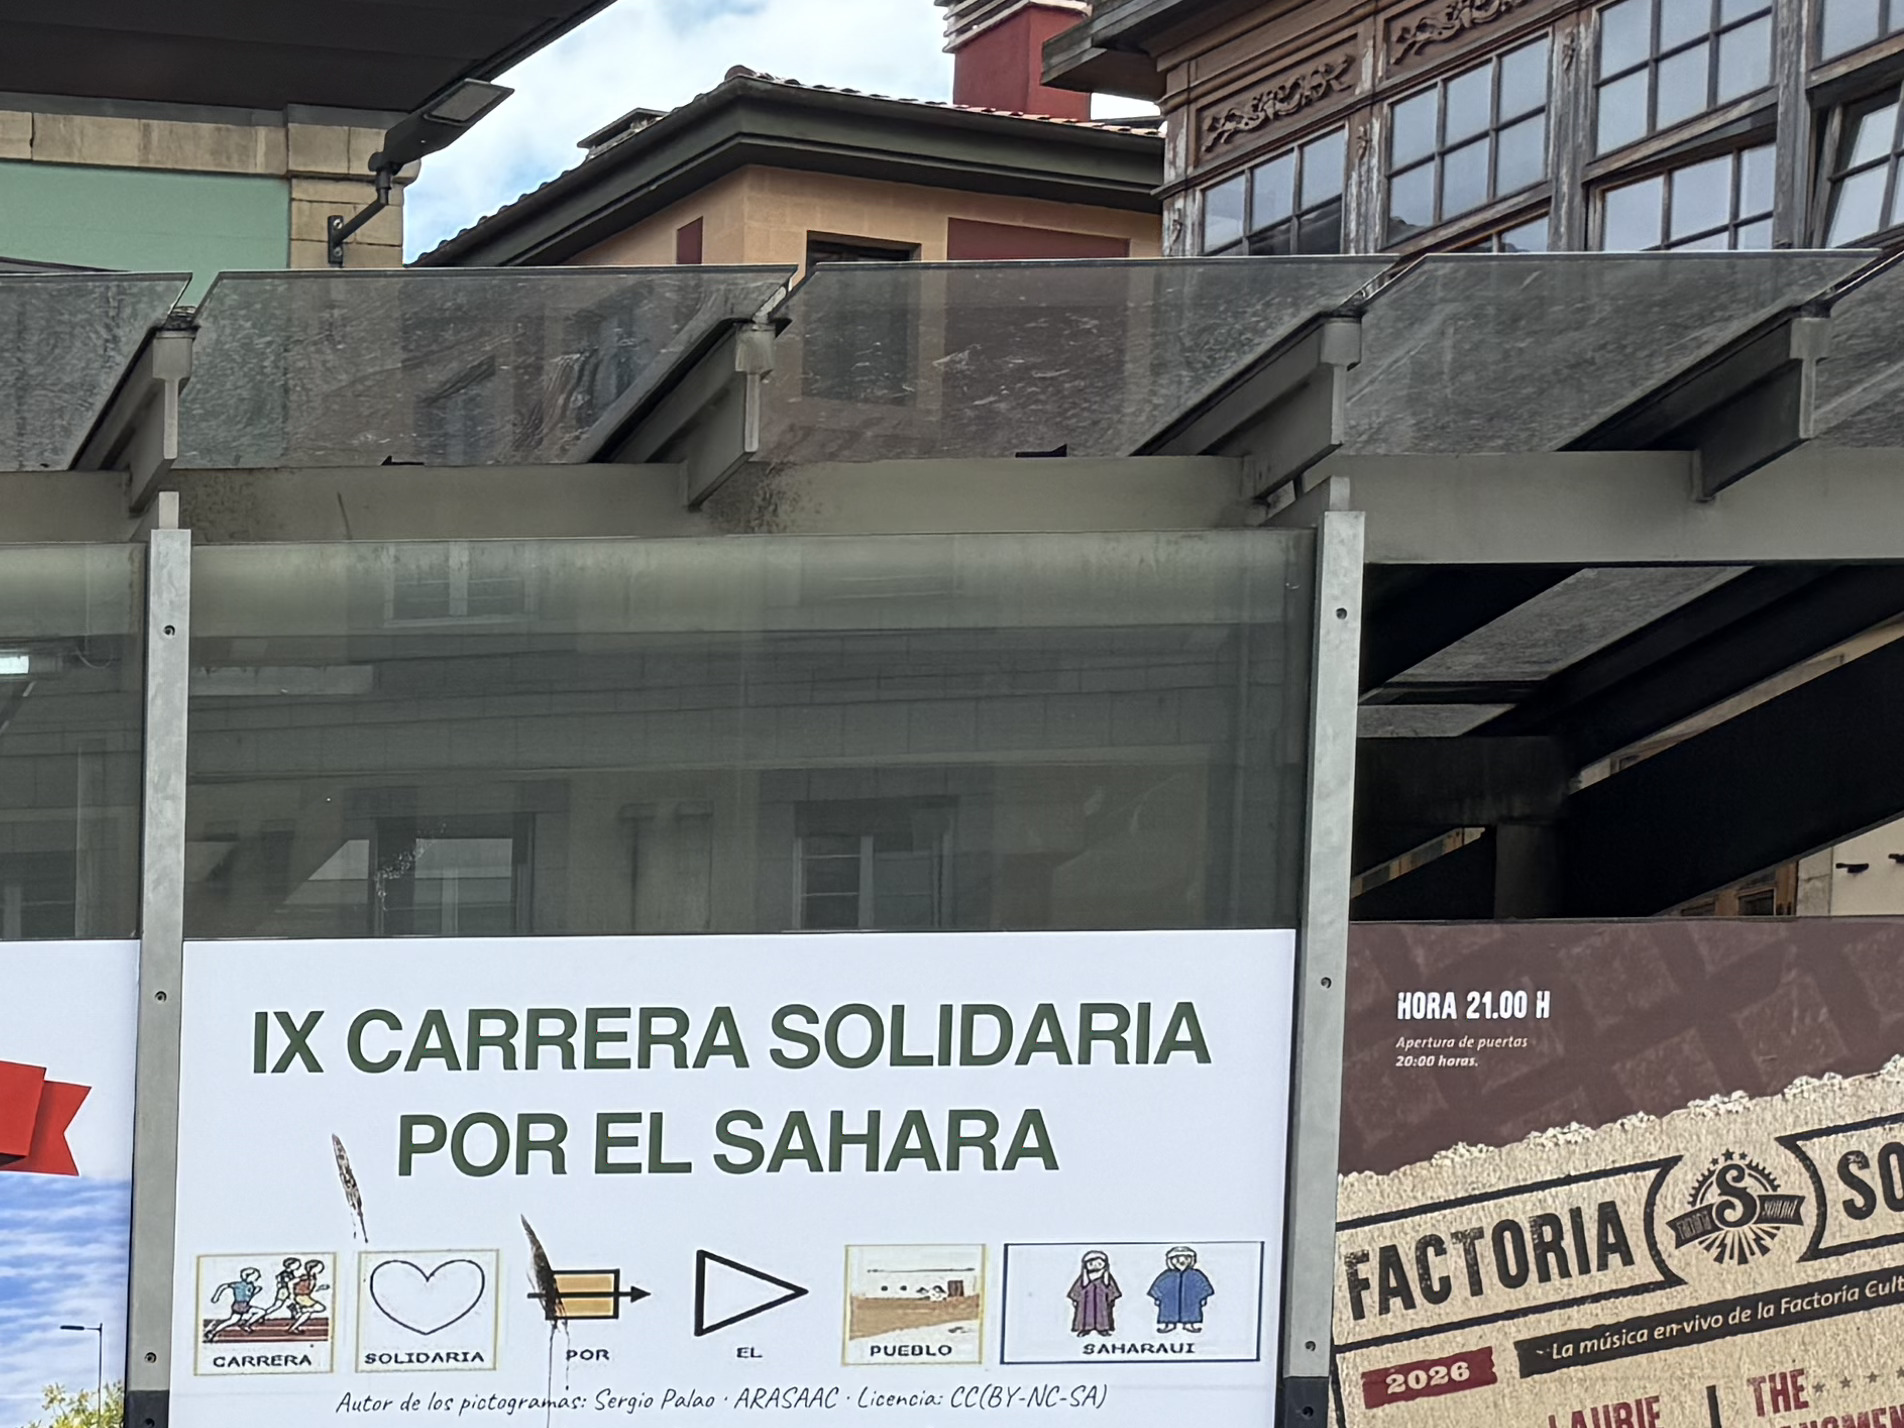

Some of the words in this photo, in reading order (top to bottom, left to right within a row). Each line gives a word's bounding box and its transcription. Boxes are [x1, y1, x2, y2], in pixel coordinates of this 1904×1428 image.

[1397, 991, 1457, 1020] HORA
[1466, 990, 1528, 1020] 21.00
[1536, 990, 1551, 1019] H
[252, 1009, 325, 1074] IX
[347, 1006, 750, 1073] CARRERA
[769, 1001, 1213, 1068] SOLIDARIA
[1395, 1036, 1455, 1051] Apertura
[1458, 1035, 1475, 1048] de
[1477, 1036, 1528, 1051] puertas
[1395, 1055, 1435, 1067] 20:00
[1438, 1054, 1479, 1067] horas.
[398, 1112, 568, 1177] POR
[594, 1111, 693, 1175] EL
[713, 1108, 1060, 1175] SAHARA
[1343, 1199, 1635, 1321] FACTORIA
[1552, 1341, 1574, 1360] La
[1579, 1325, 1648, 1354] música
[1727, 1305, 1752, 1325] de
[1756, 1301, 1775, 1320] la
[1780, 1284, 1860, 1316] Factoría
[212, 1353, 313, 1369] CARRERA
[363, 1349, 486, 1366] SOLIDARIA
[565, 1348, 611, 1362] POR
[735, 1346, 764, 1359] EL
[869, 1344, 953, 1358] PUEBLO
[1082, 1342, 1196, 1355] SAHARAUI
[1385, 1361, 1471, 1394] 2026
[1747, 1368, 1810, 1418] THE
[336, 1391, 394, 1413] Autor
[399, 1391, 420, 1412] de
[427, 1391, 453, 1412] los
[458, 1390, 588, 1416] pictogramas:
[593, 1388, 652, 1415] Sergio
[660, 1387, 716, 1411] Palao
[733, 1386, 840, 1409] ARASAAC
[857, 1386, 944, 1409] Licencia:
[949, 1384, 1109, 1409] CC(BY-NC-SA)
